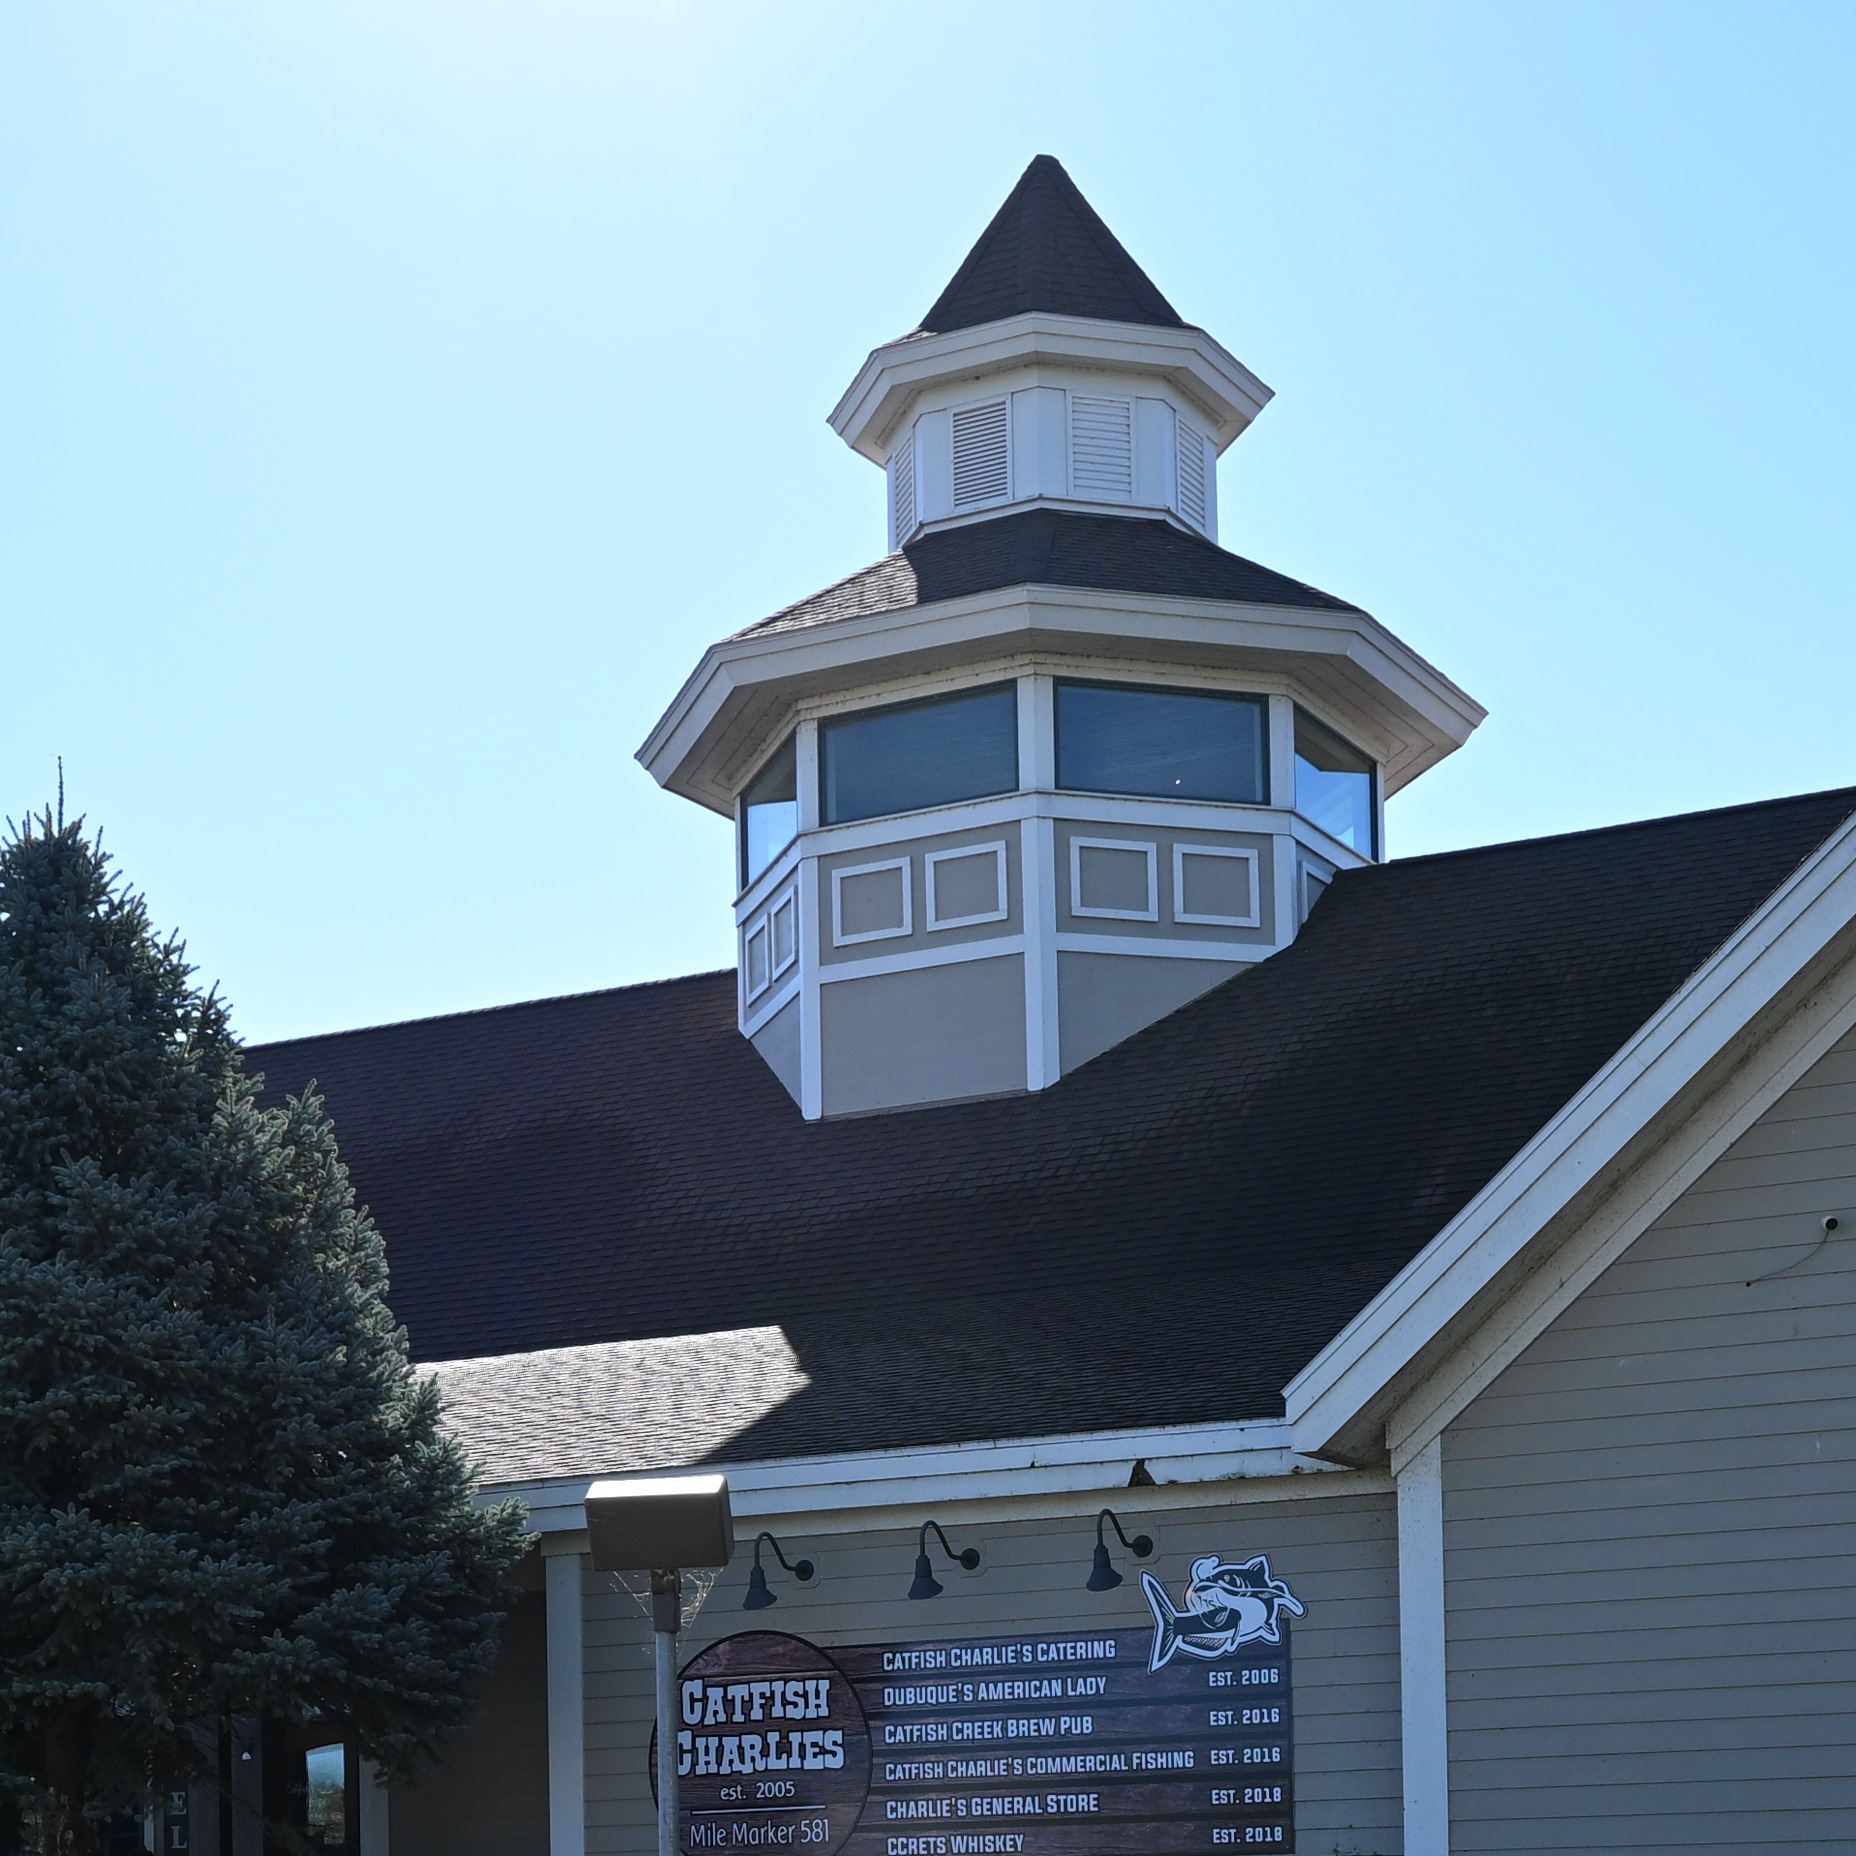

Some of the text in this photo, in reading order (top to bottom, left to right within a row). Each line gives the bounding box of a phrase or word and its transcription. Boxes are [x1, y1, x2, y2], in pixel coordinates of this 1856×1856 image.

[883, 1640, 1116, 1671] CATFISH CHARLIE'S CATERING
[1209, 1669, 1279, 1686] EST. 2006
[681, 1679, 830, 1725] CATFISH
[884, 1677, 1106, 1706] DUBUQUE'S AMERICAN LADY
[1210, 1708, 1280, 1726] EST. 2016
[884, 1716, 1093, 1744] CATFISH CREEK BREW PUB
[677, 1729, 844, 1776] CHARLIES
[1210, 1747, 1281, 1765] EST. 2016
[885, 1751, 1194, 1781] CATFISH CHARLIE'S COMMERCIAL FISHING
[720, 1781, 795, 1800] est. 2005
[1212, 1787, 1282, 1804] EST. 2018
[886, 1794, 1098, 1819] CHARLIE'S GENERAL STORE
[690, 1818, 829, 1847] Mile Marker 581
[887, 1834, 1024, 1856] CCRETS WHISKEY
[1213, 1826, 1283, 1844] EST. 2018
